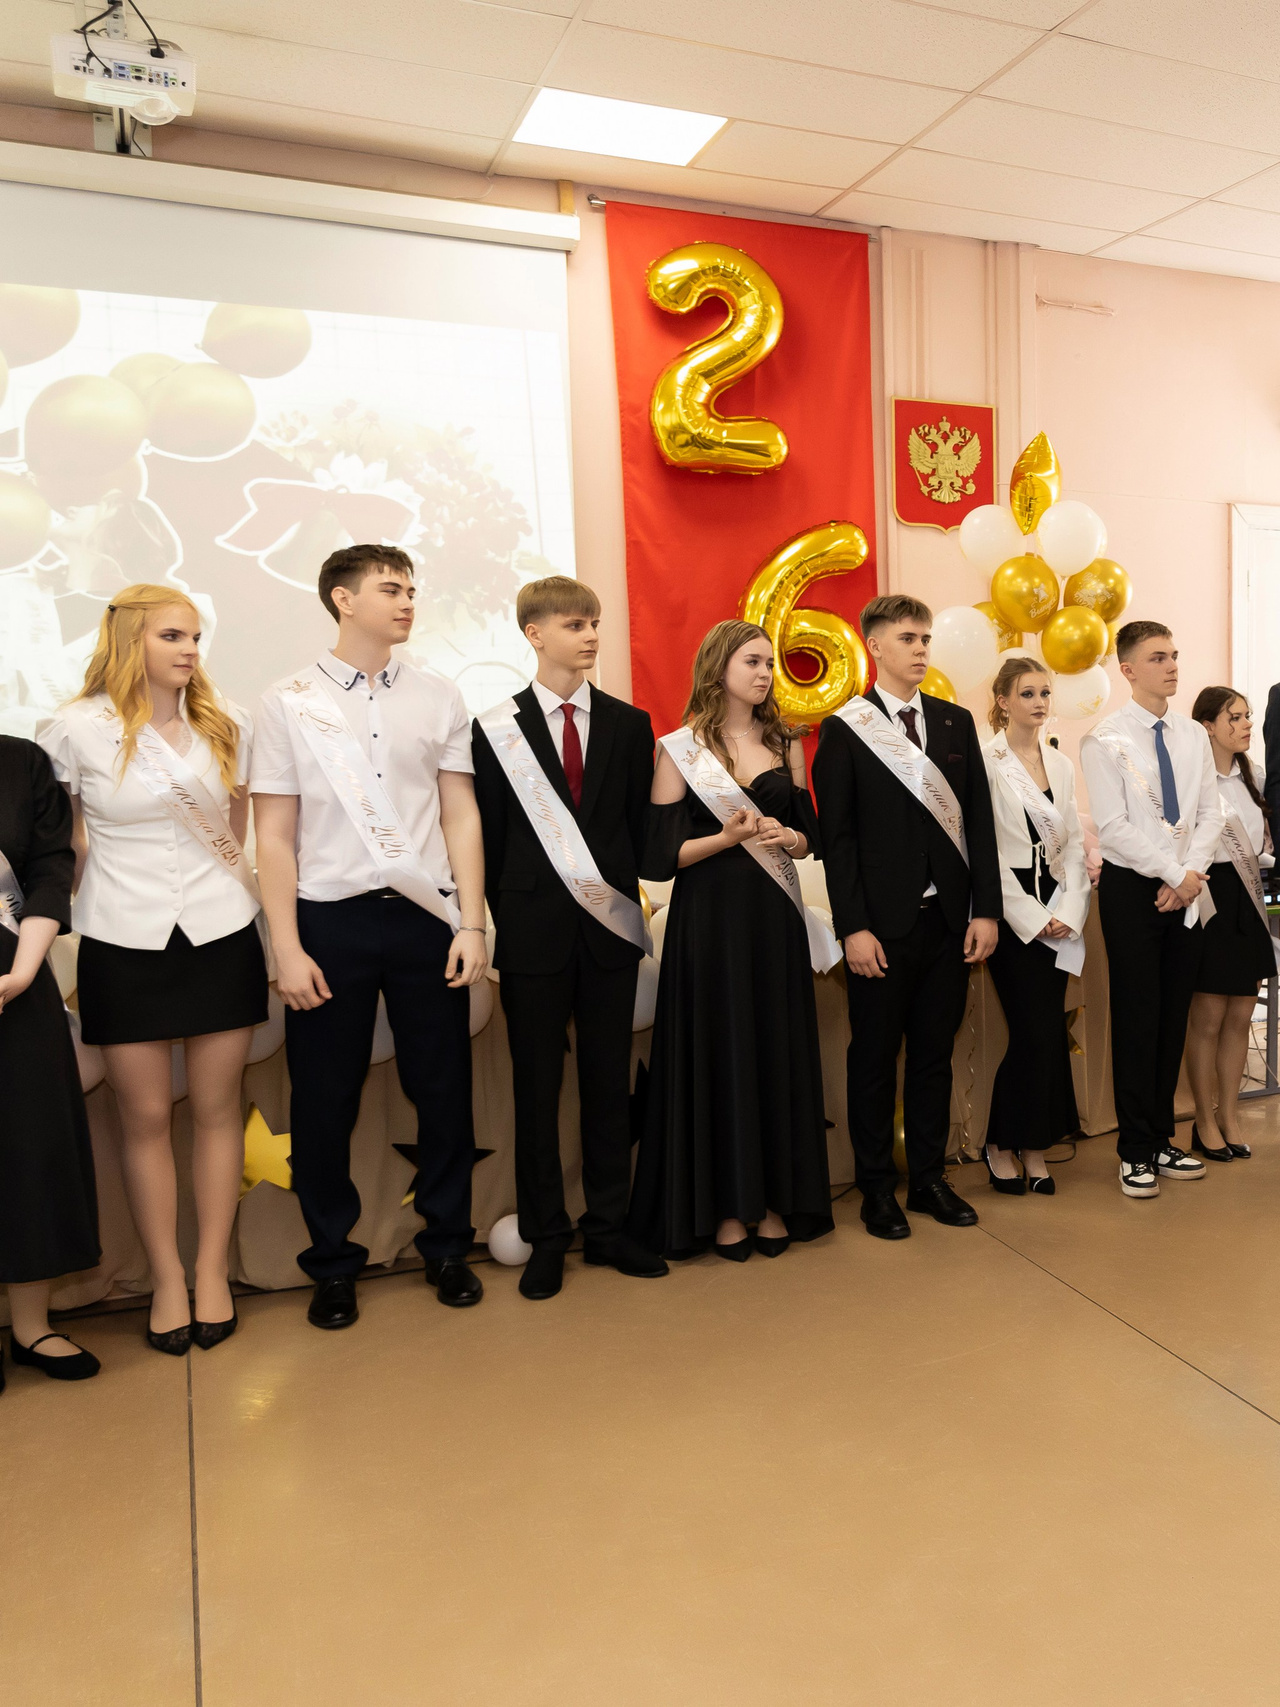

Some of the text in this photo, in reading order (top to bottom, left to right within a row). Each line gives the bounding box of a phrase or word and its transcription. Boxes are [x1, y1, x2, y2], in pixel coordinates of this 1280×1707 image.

[645, 240, 790, 477] 2
[738, 520, 870, 729] 6
[211, 833, 242, 867] 2026
[369, 825, 412, 859] 2026
[775, 857, 796, 887] 2026
[572, 876, 613, 906] 2026
